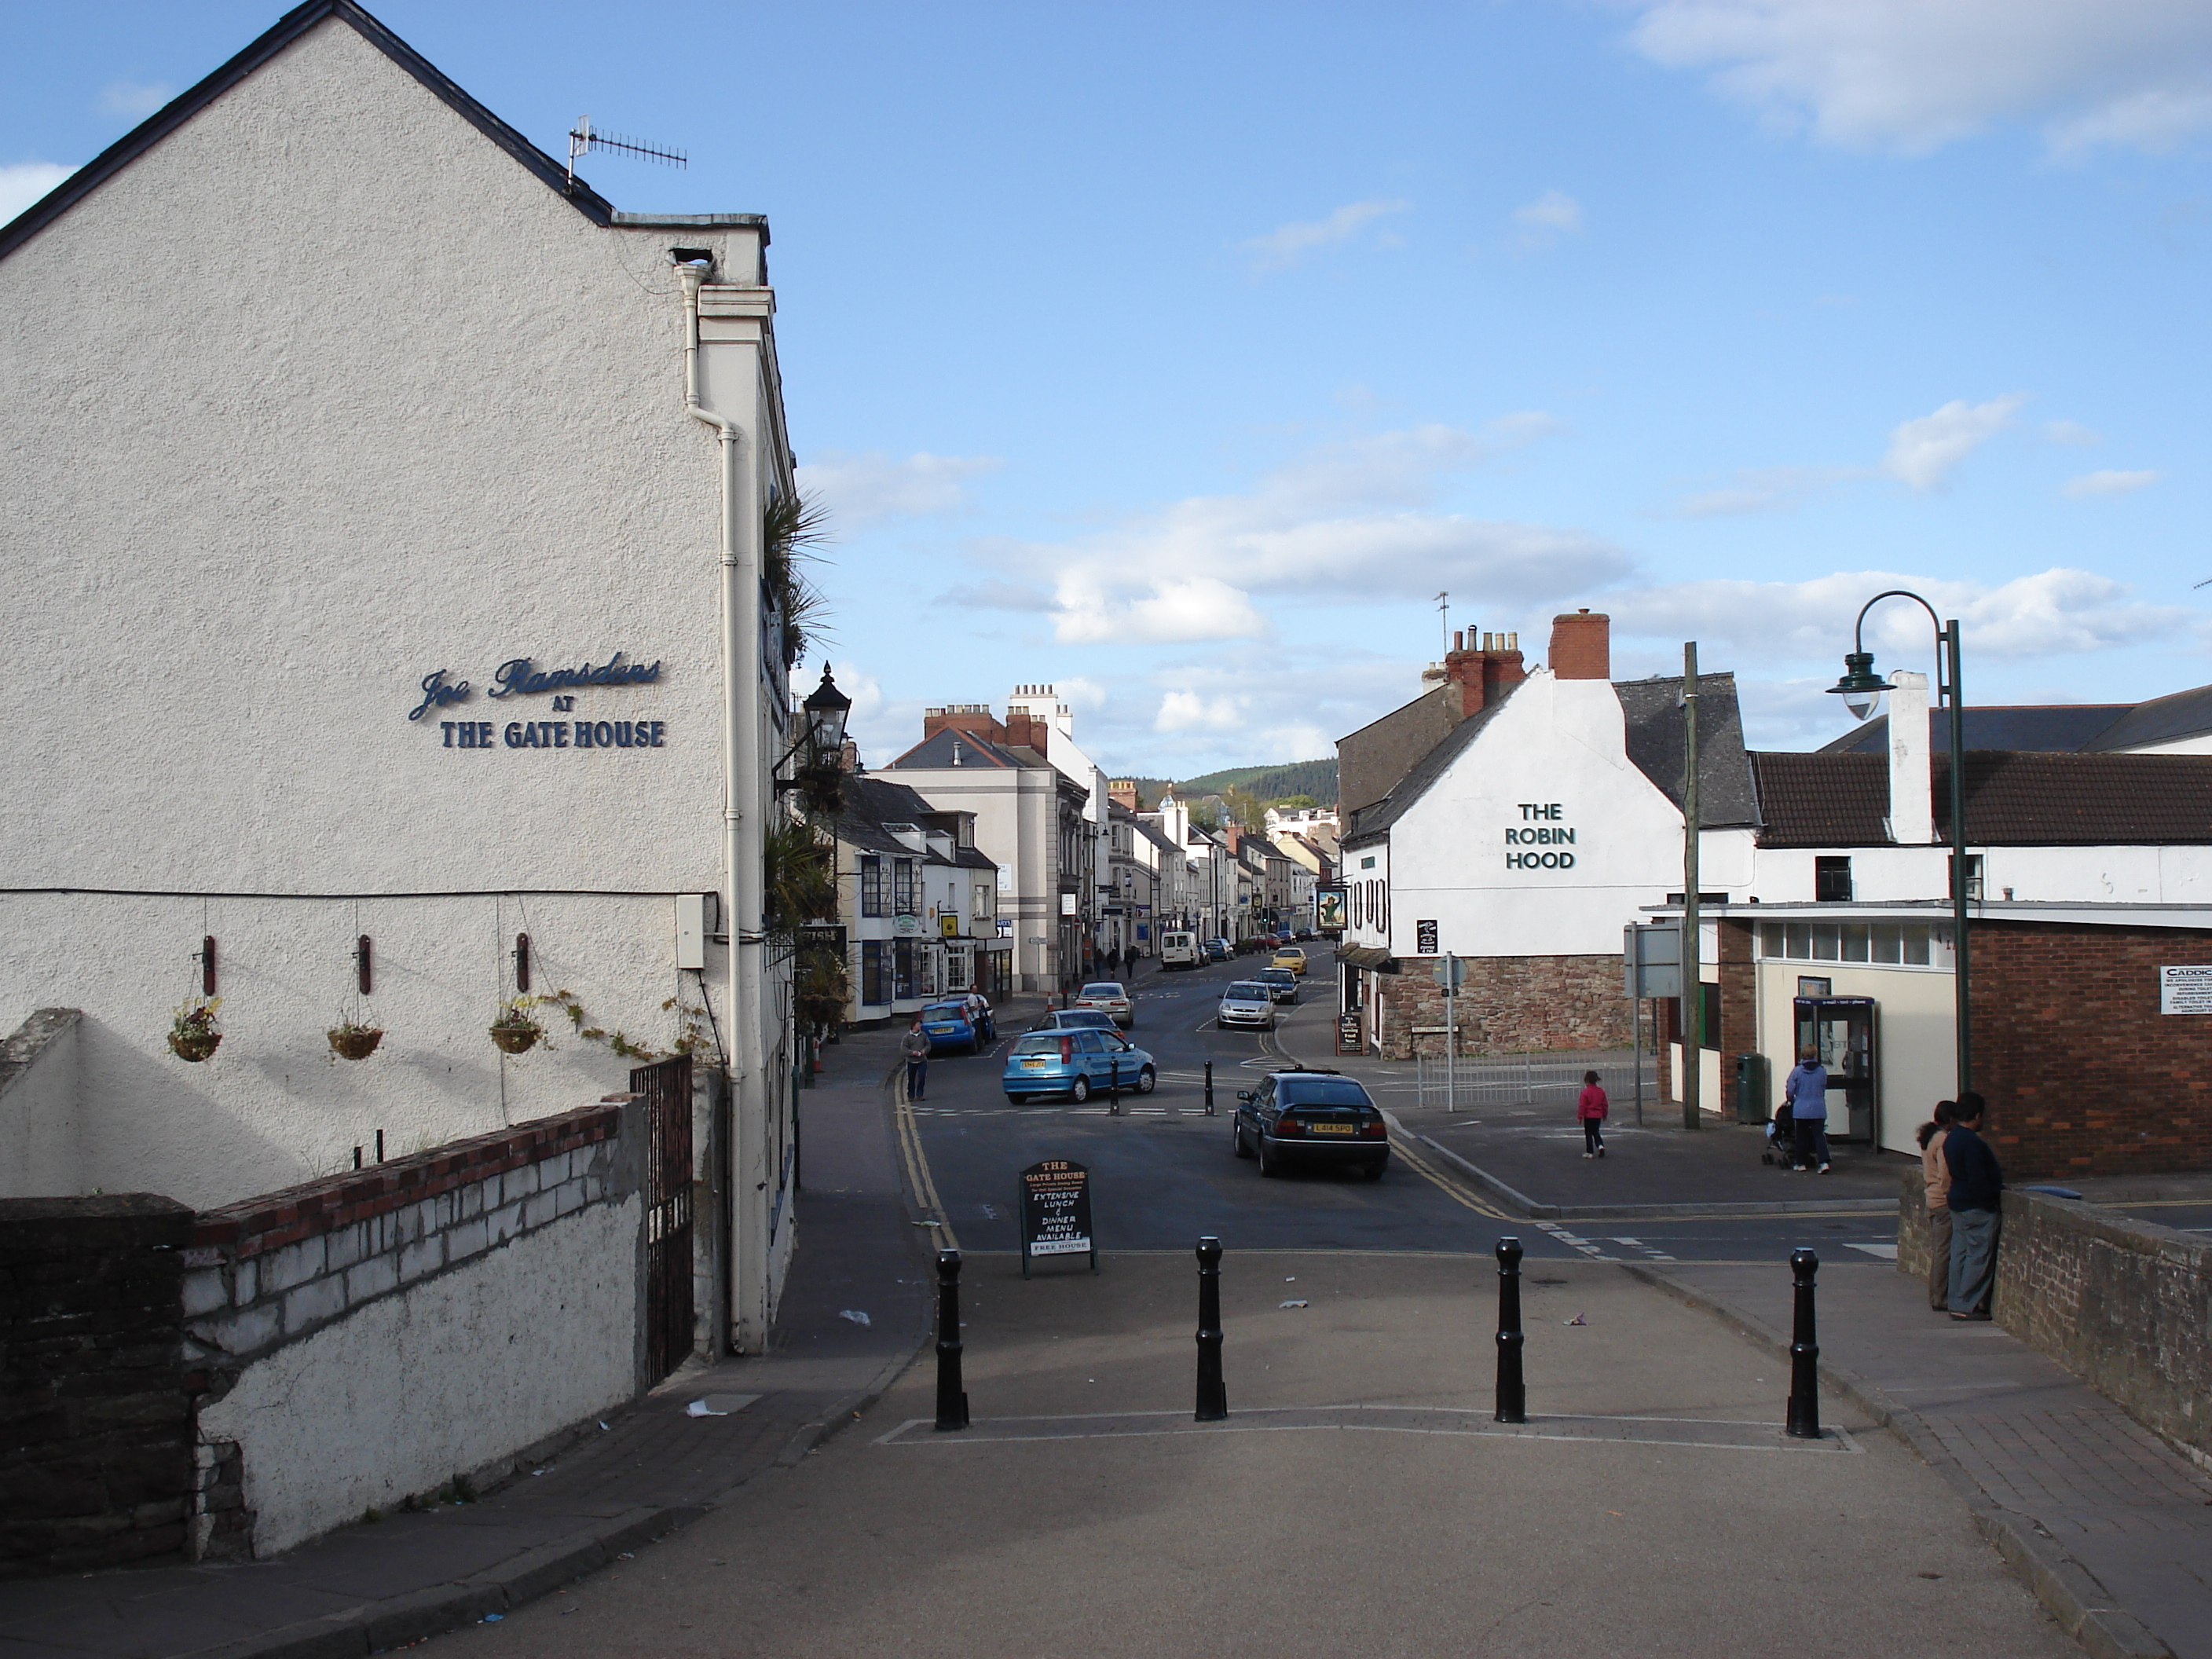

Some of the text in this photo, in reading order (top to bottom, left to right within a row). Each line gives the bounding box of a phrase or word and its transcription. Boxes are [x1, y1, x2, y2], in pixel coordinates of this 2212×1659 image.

[408, 652, 661, 720] Joe Ramsdens
[552, 696, 573, 712] AT
[441, 721, 664, 747] THE GATE HOUSE
[1517, 804, 1562, 820] THE
[1505, 827, 1576, 844] ROBIN
[1506, 852, 1576, 869] HOOD
[1042, 1162, 1068, 1170] THE
[1034, 1192, 1079, 1200] EXTENSIVE
[1042, 1216, 1076, 1225] DINNER
[1037, 1232, 1081, 1241] AVAILABLE
